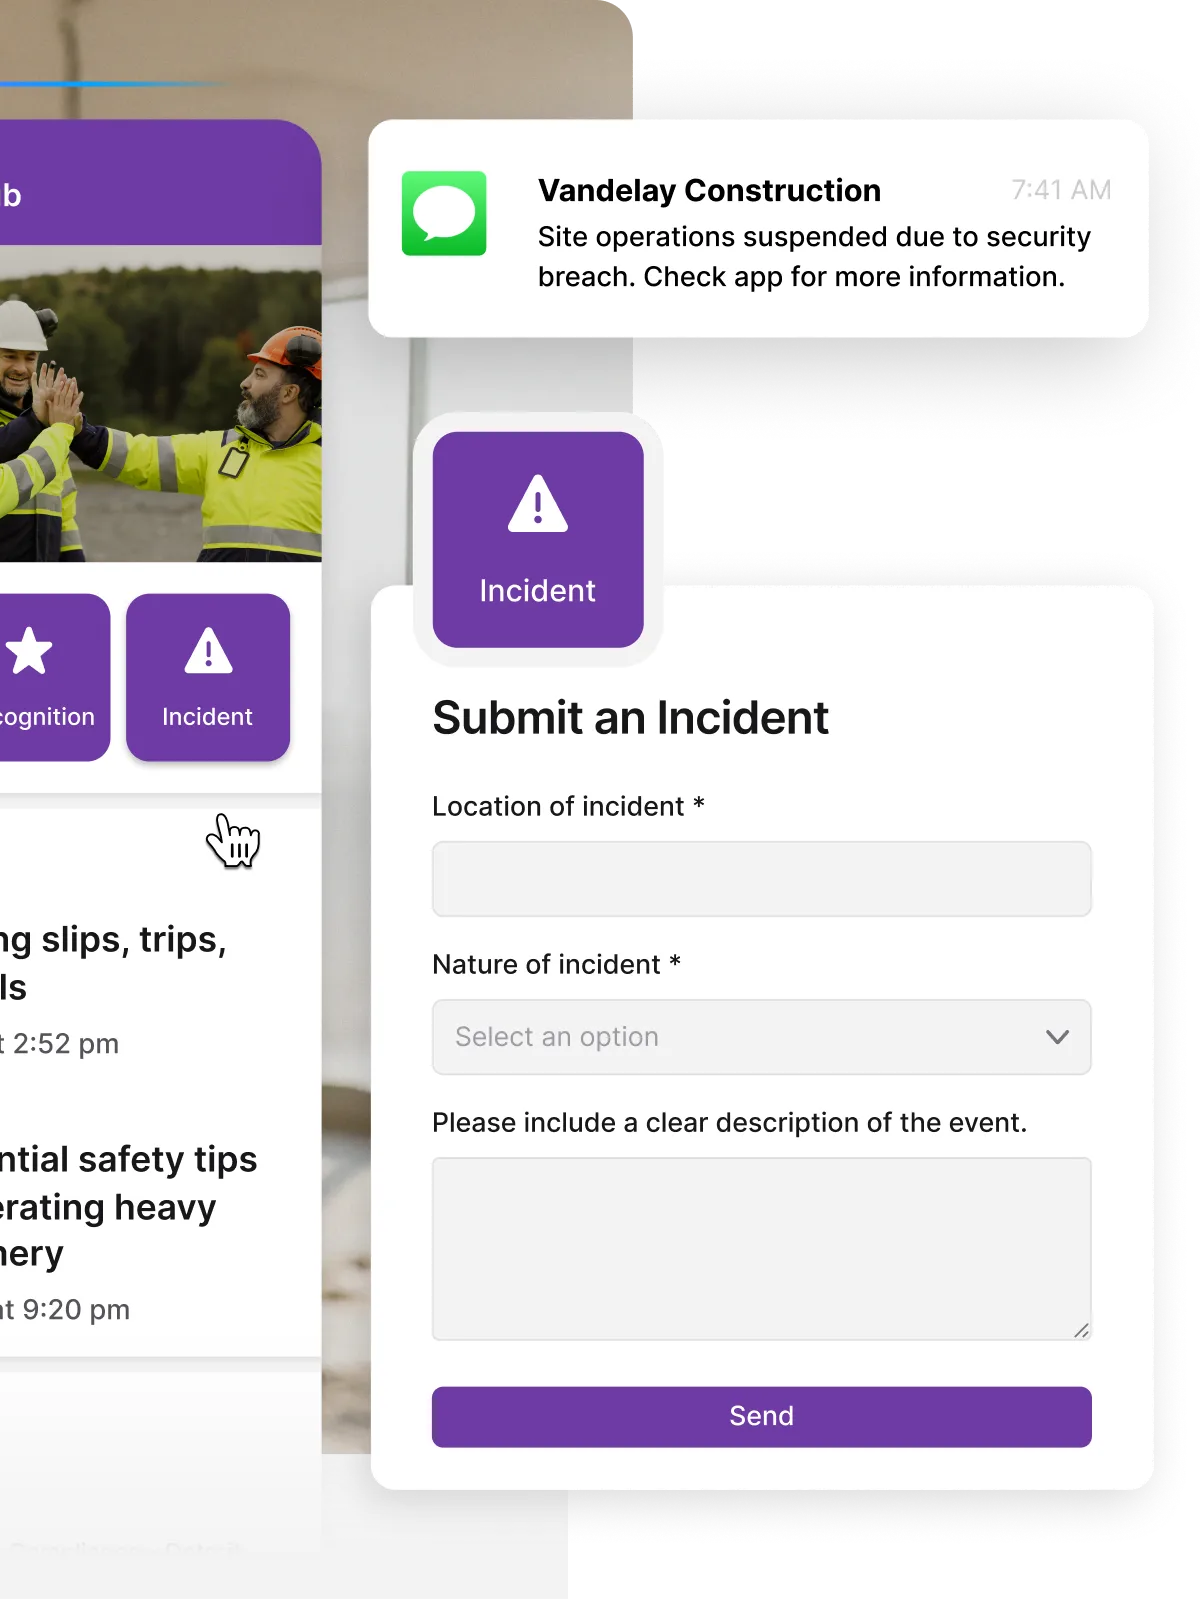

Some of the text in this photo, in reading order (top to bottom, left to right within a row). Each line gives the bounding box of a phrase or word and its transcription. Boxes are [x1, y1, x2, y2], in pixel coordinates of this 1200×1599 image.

[537, 176, 881, 209] Vandelay Construction
[1011, 178, 1111, 200] 7:41 AM
[538, 224, 1092, 253] Site operations suspended due to security
[539, 264, 1065, 293] breach. Check app for more information.
[481, 577, 596, 603] Incident
[163, 706, 253, 726] Incident
[433, 698, 830, 735] Submit an Incident
[433, 794, 541, 817] Location
[549, 794, 576, 817] of
[583, 794, 685, 817] incident
[42, 923, 129, 960] slips,
[139, 923, 226, 960] trips,
[433, 953, 518, 975] Nature
[525, 952, 552, 975] of
[559, 952, 661, 975] incident
[13, 1032, 70, 1055] 2:52
[79, 1037, 119, 1060] pm
[455, 1025, 659, 1053] Select an option
[433, 1110, 1027, 1138] Please include a clear description of the event.
[78, 1143, 185, 1180] safety
[193, 1143, 258, 1180] tips
[115, 1193, 217, 1228] heavy
[23, 1298, 82, 1321] 9:20
[90, 1303, 130, 1326] pm
[729, 1404, 794, 1427] Send
